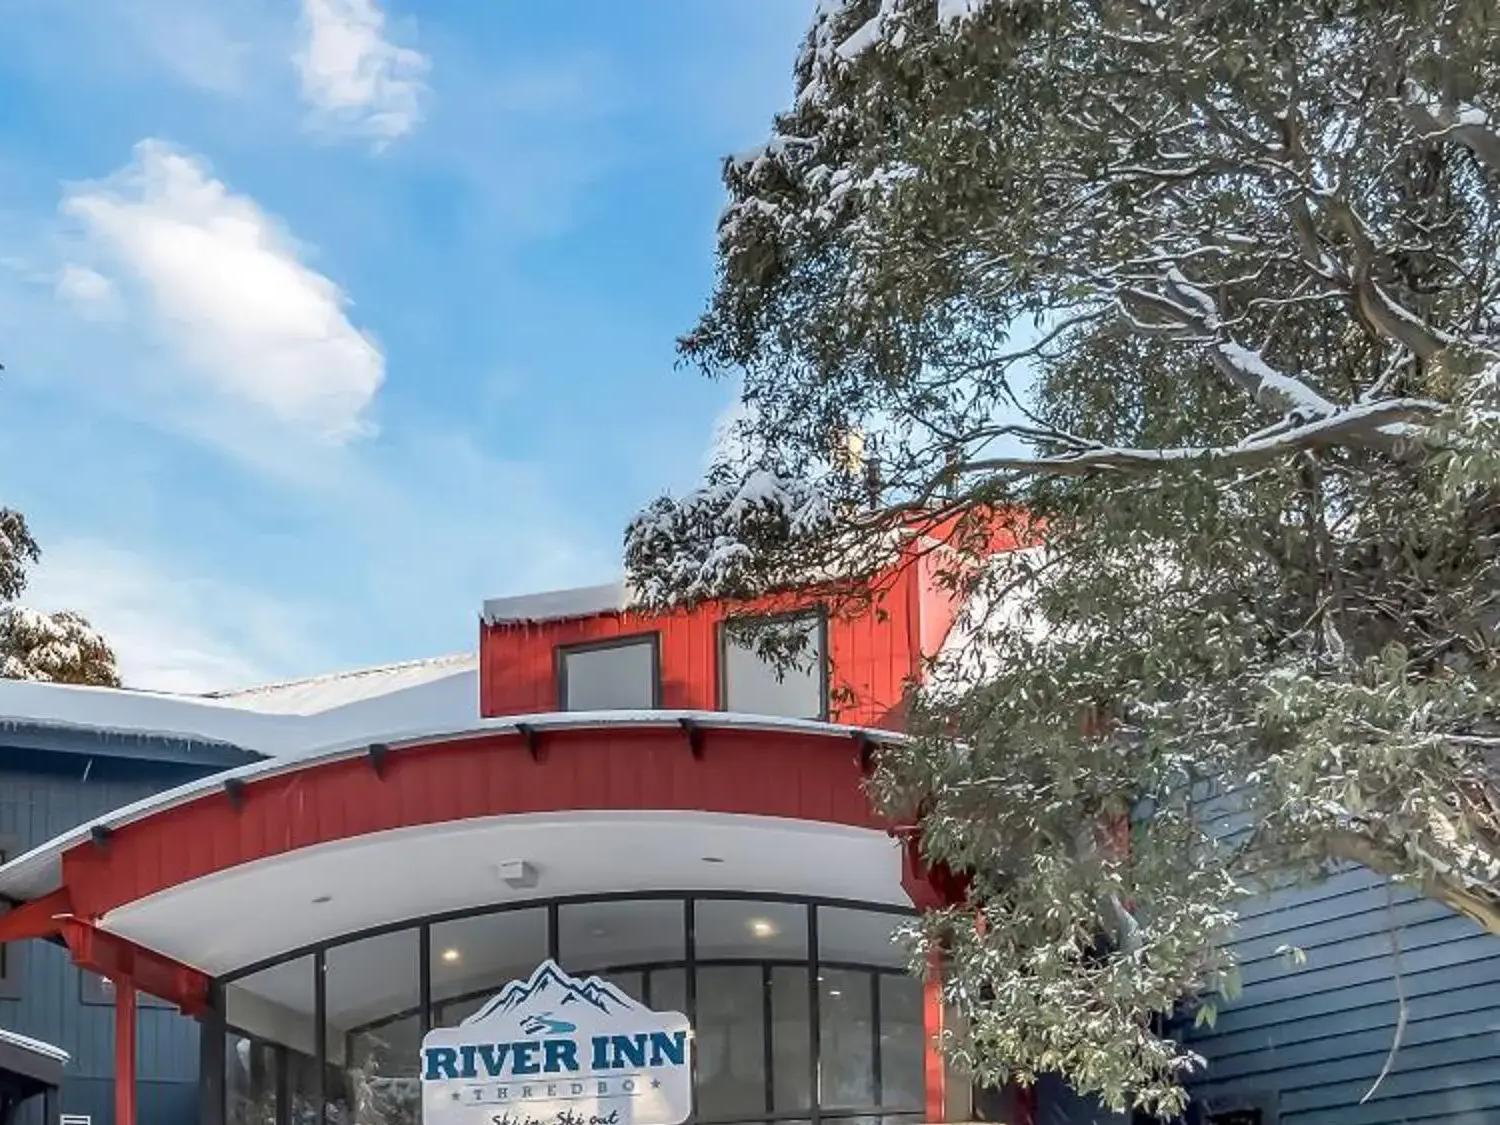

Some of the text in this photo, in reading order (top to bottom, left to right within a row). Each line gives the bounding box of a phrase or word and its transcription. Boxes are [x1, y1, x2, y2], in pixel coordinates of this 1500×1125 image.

[425, 1031, 687, 1080] RIVER INN
[473, 1080, 635, 1101] THREDBO
[590, 1109, 619, 1125] out
